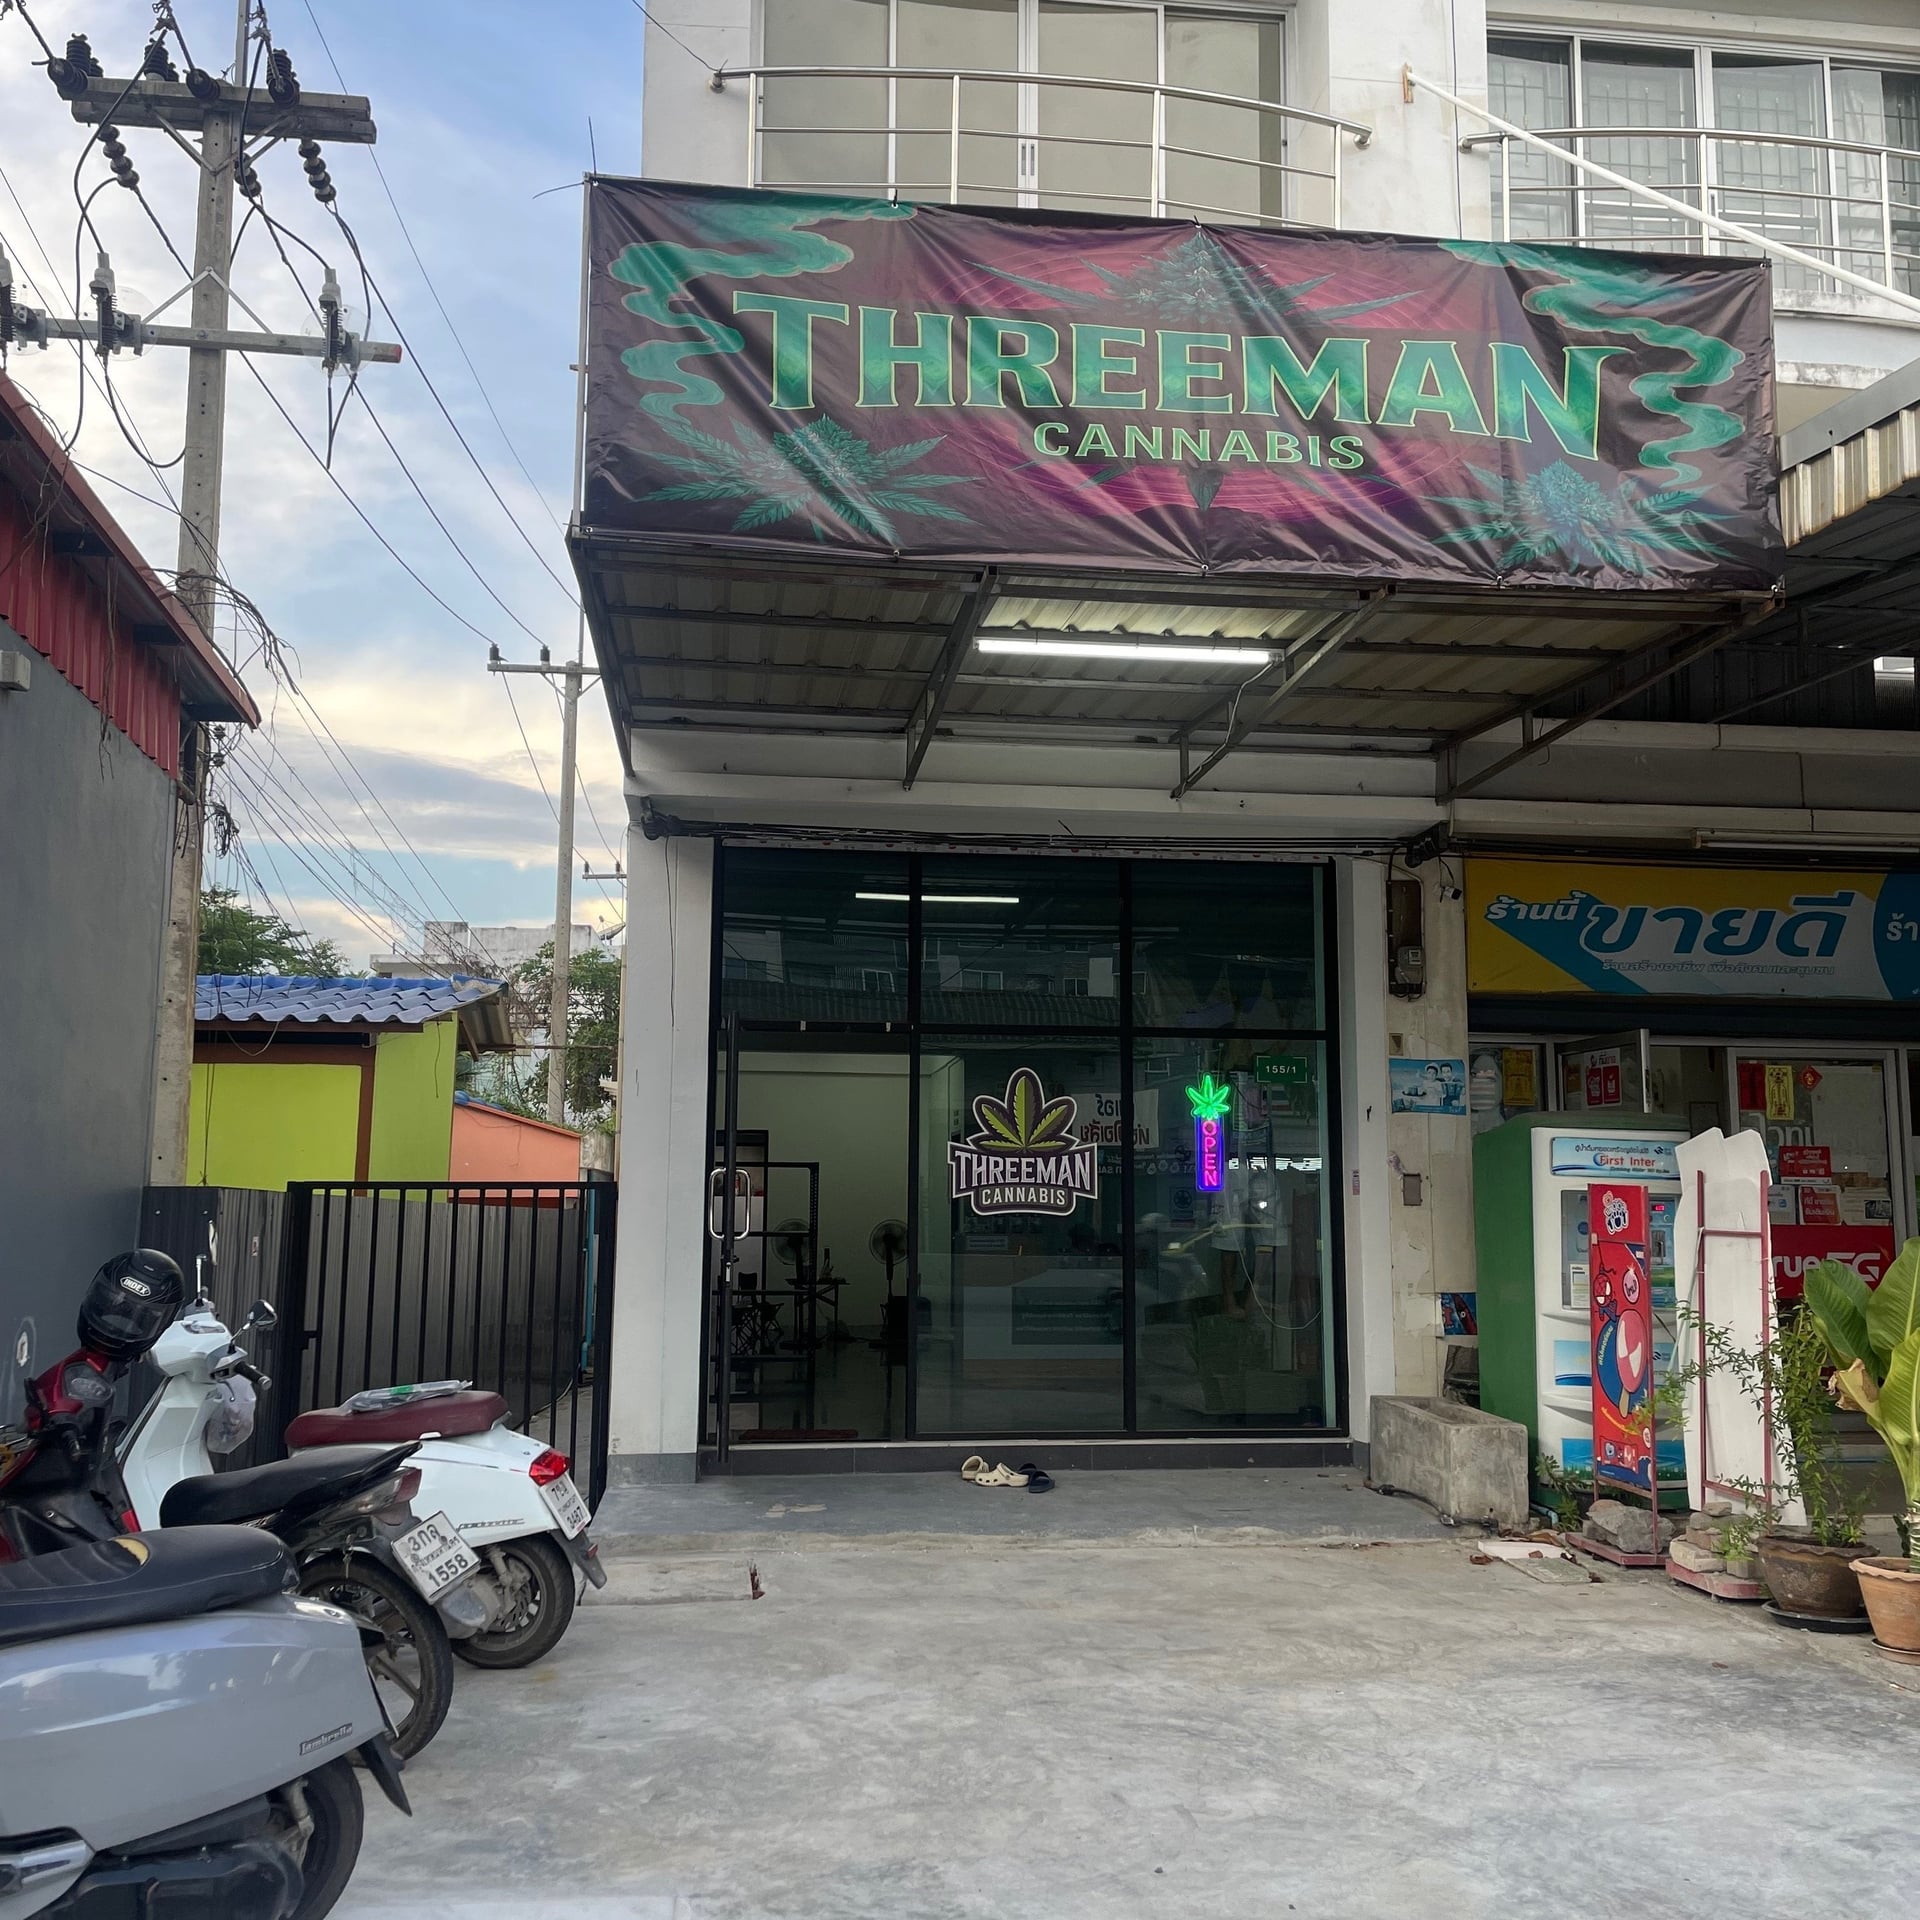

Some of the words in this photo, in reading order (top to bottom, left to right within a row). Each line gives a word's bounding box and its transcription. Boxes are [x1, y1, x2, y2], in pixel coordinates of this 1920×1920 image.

[733, 289, 1634, 462] THREEMAN
[1032, 421, 1366, 471] CANNABIS
[1486, 889, 1587, 921] ร้านนี้
[1582, 889, 1857, 958] ขายดี
[1265, 1065, 1297, 1074] 155/1
[954, 1150, 1091, 1191] THREEMAN
[1202, 1120, 1218, 1187] OPEN
[1599, 1154, 1624, 1166] First
[1630, 1156, 1656, 1167] Inter
[981, 1186, 1066, 1206] CANNABIS
[123, 1278, 147, 1295] INDEX
[429, 1554, 468, 1588] 1558
